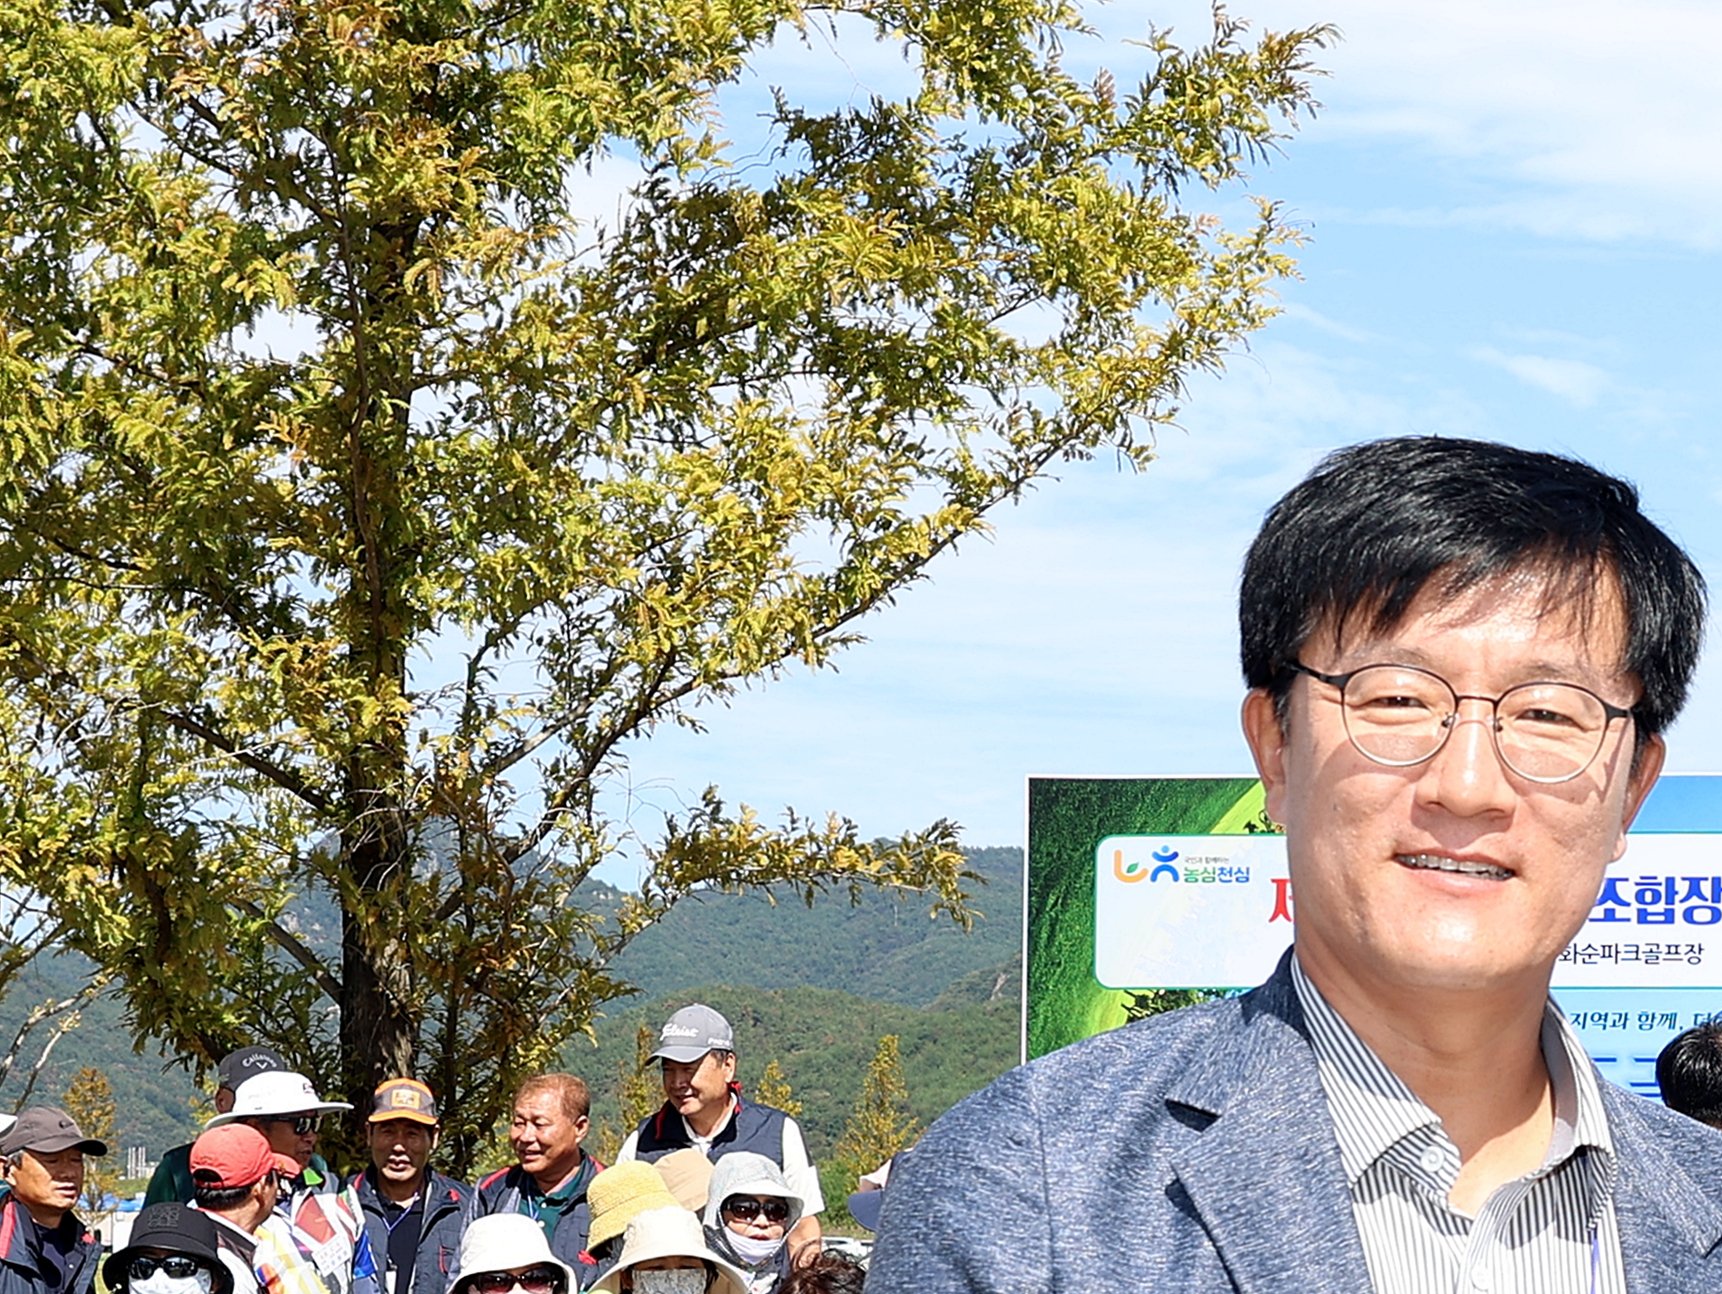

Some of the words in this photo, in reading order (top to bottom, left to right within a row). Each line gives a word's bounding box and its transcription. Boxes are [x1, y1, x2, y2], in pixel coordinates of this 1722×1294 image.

[1184, 866, 1250, 883] 농심천심
[1571, 1011, 1629, 1030] 지역과
[1637, 1011, 1684, 1031] 함께,
